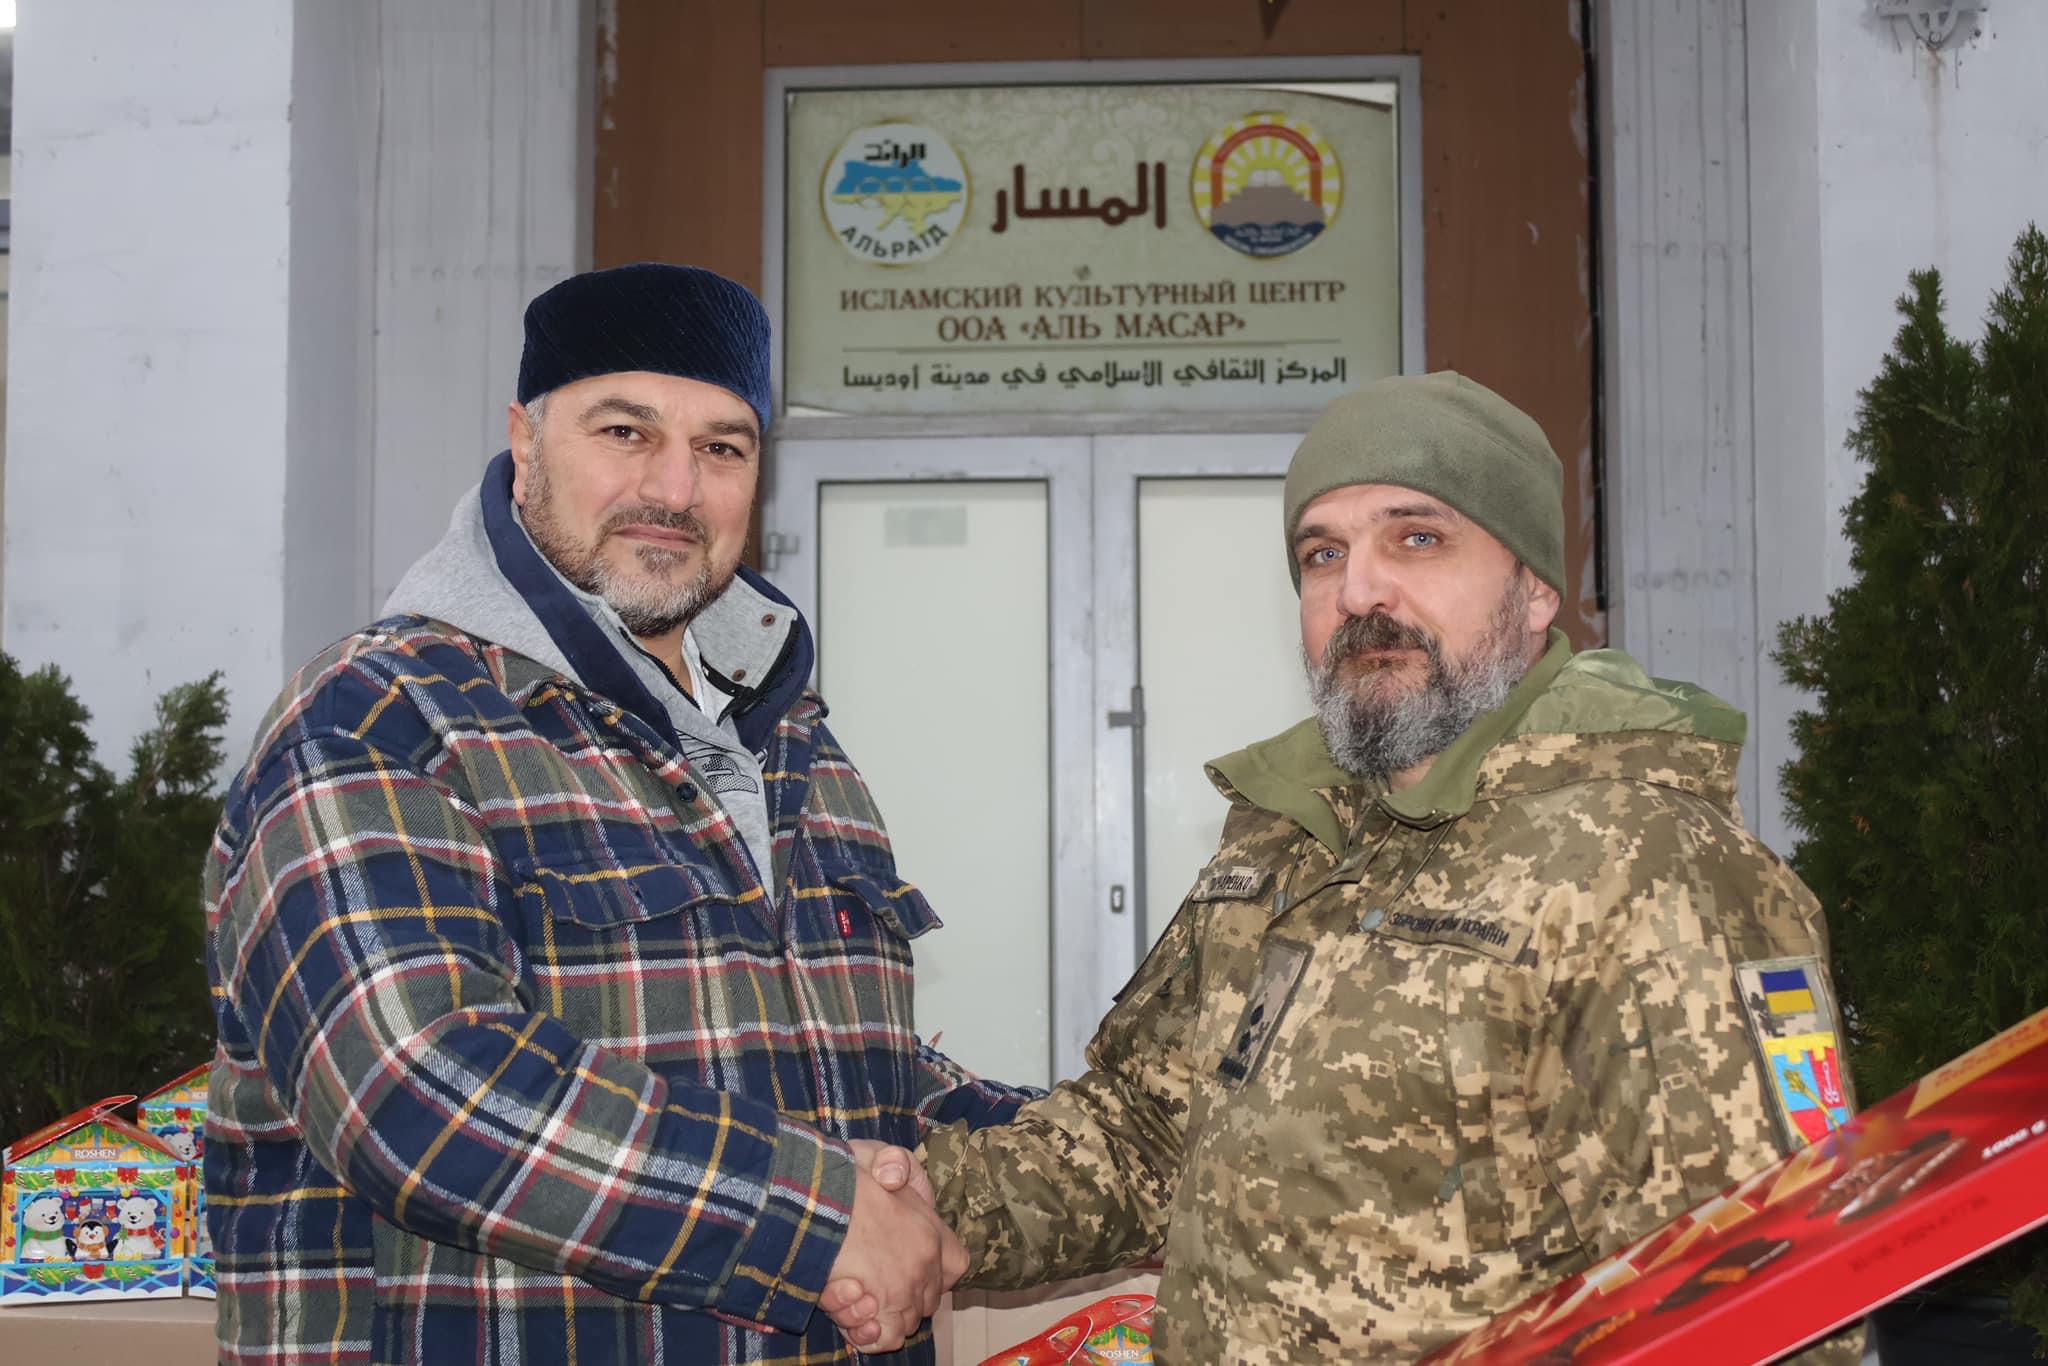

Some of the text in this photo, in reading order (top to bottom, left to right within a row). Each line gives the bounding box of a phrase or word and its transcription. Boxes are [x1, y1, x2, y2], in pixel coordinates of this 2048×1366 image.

[991, 161, 1167, 234] المسار
[840, 280, 1345, 311] ИСЛАМСКИЙ КУЛЬТУРНЫЙ ЦЕНТР
[938, 316, 1006, 342] ООА
[930, 363, 990, 391] مدينة
[1001, 362, 1046, 390] في
[1173, 358, 1265, 387] الثقافي
[1276, 357, 1346, 384] المركز
[74, 1148, 116, 1160] ROSHEN
